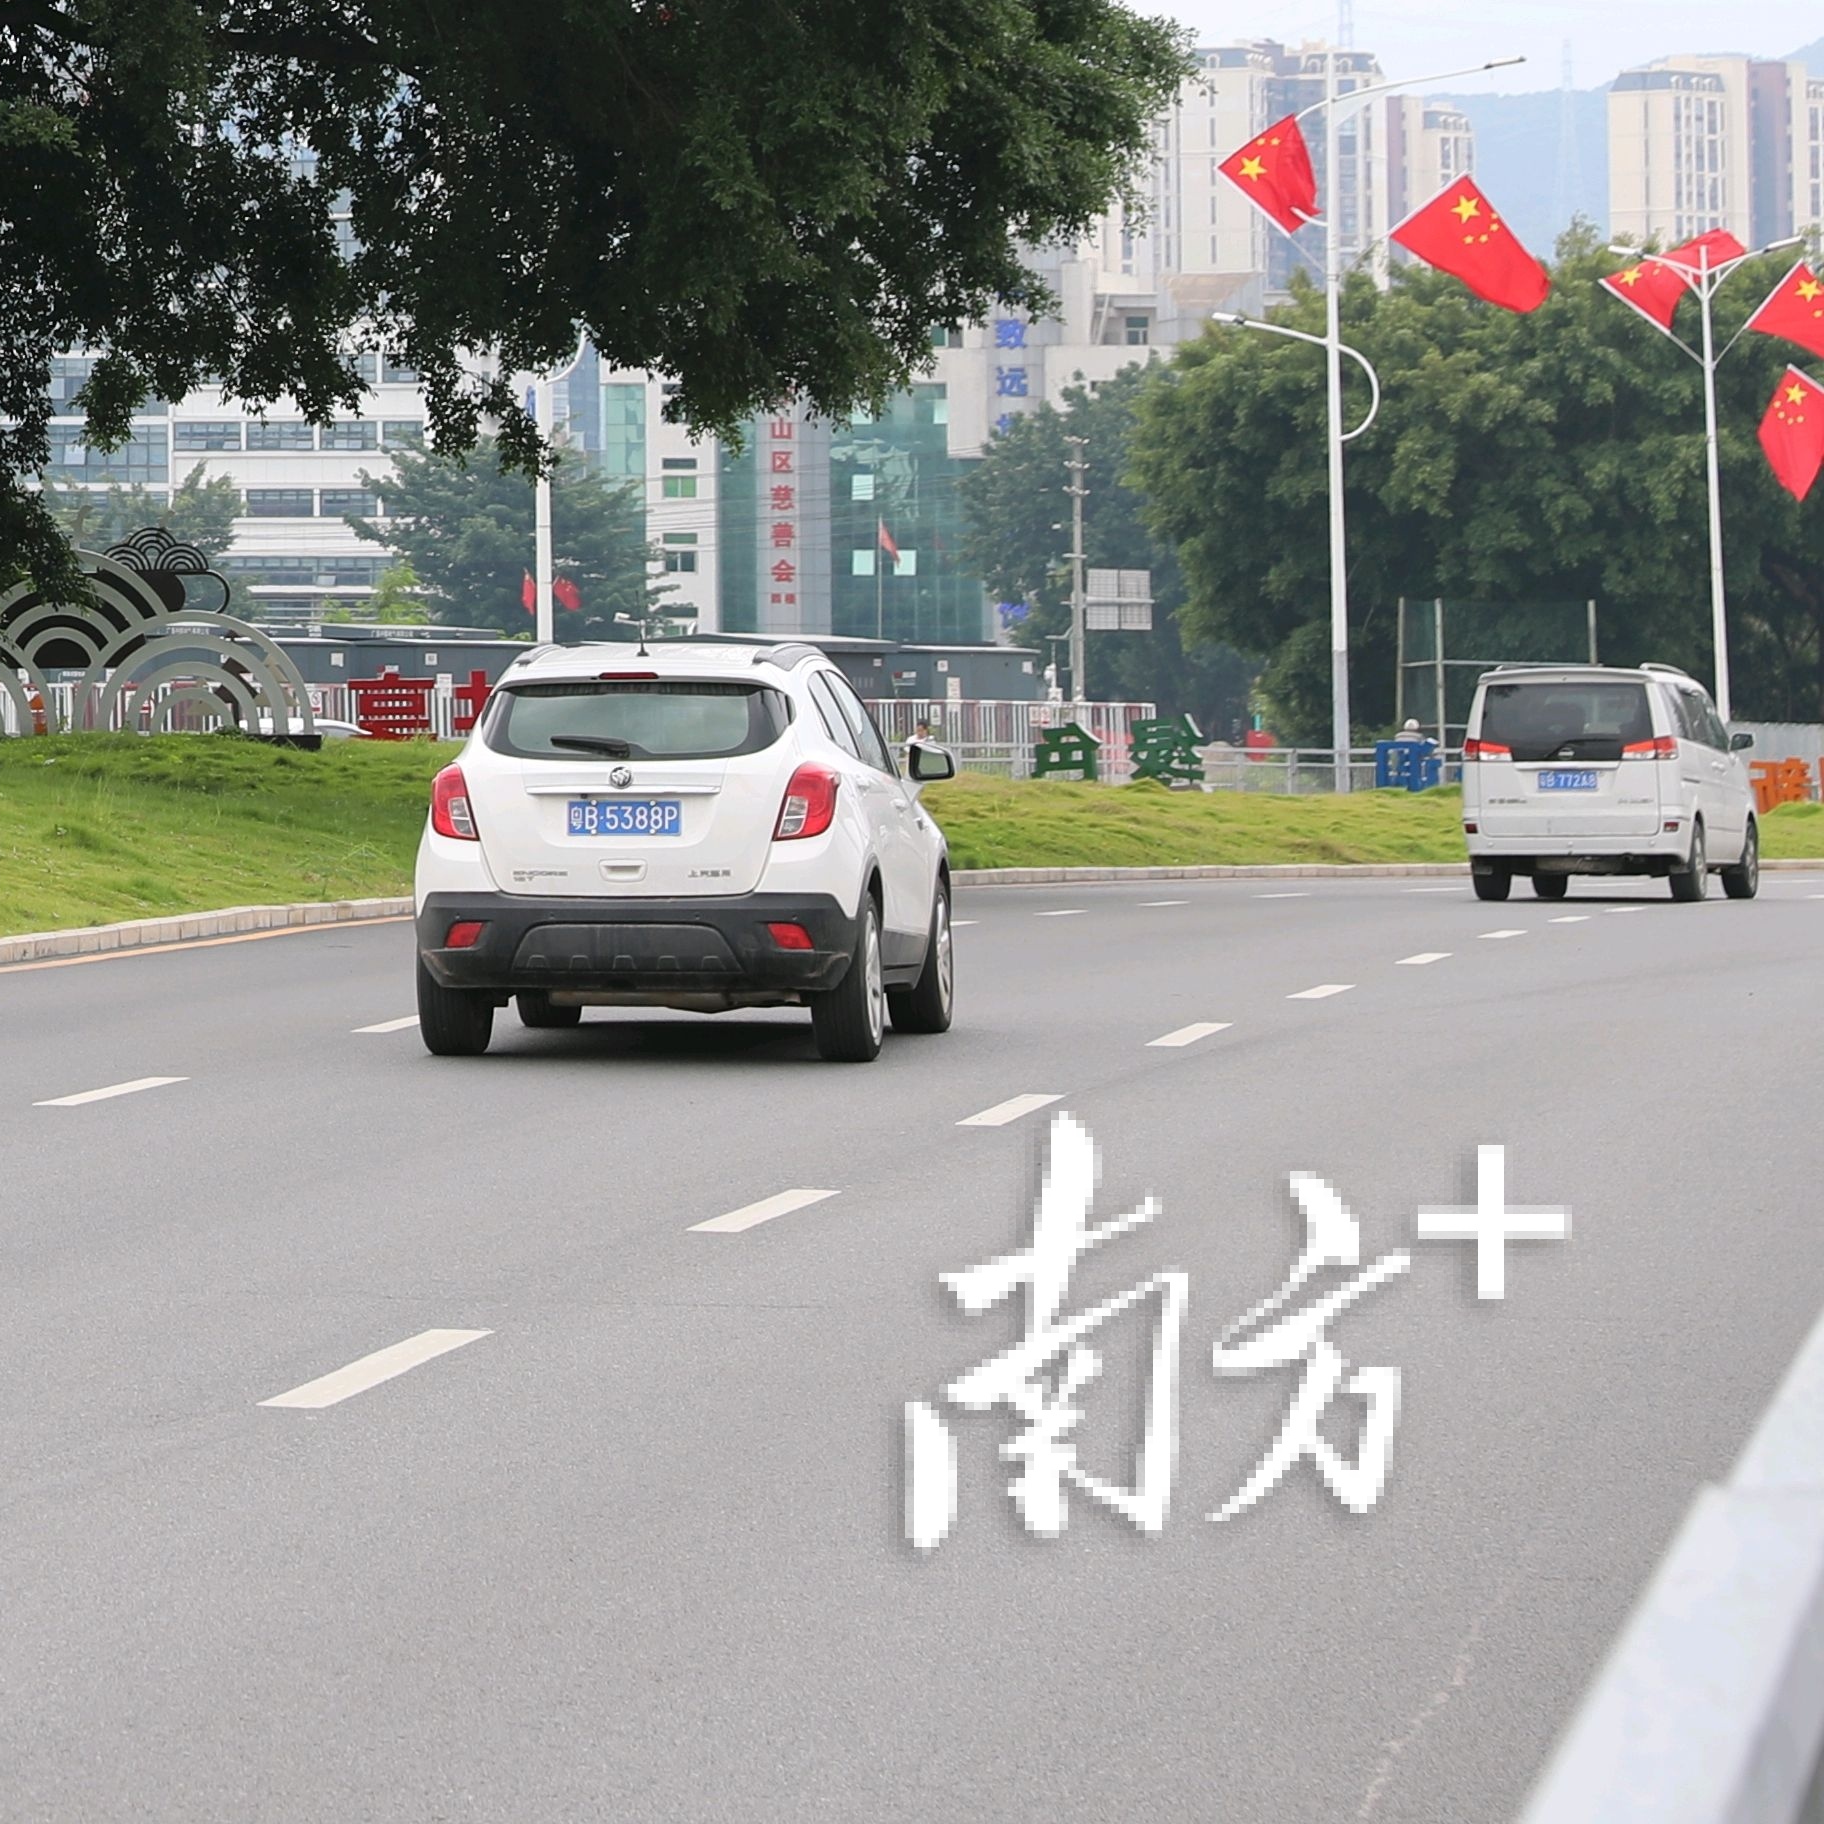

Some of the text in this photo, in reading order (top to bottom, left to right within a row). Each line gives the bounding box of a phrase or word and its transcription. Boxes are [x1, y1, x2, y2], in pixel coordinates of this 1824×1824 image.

[770, 385, 796, 583] 山区慈善会
